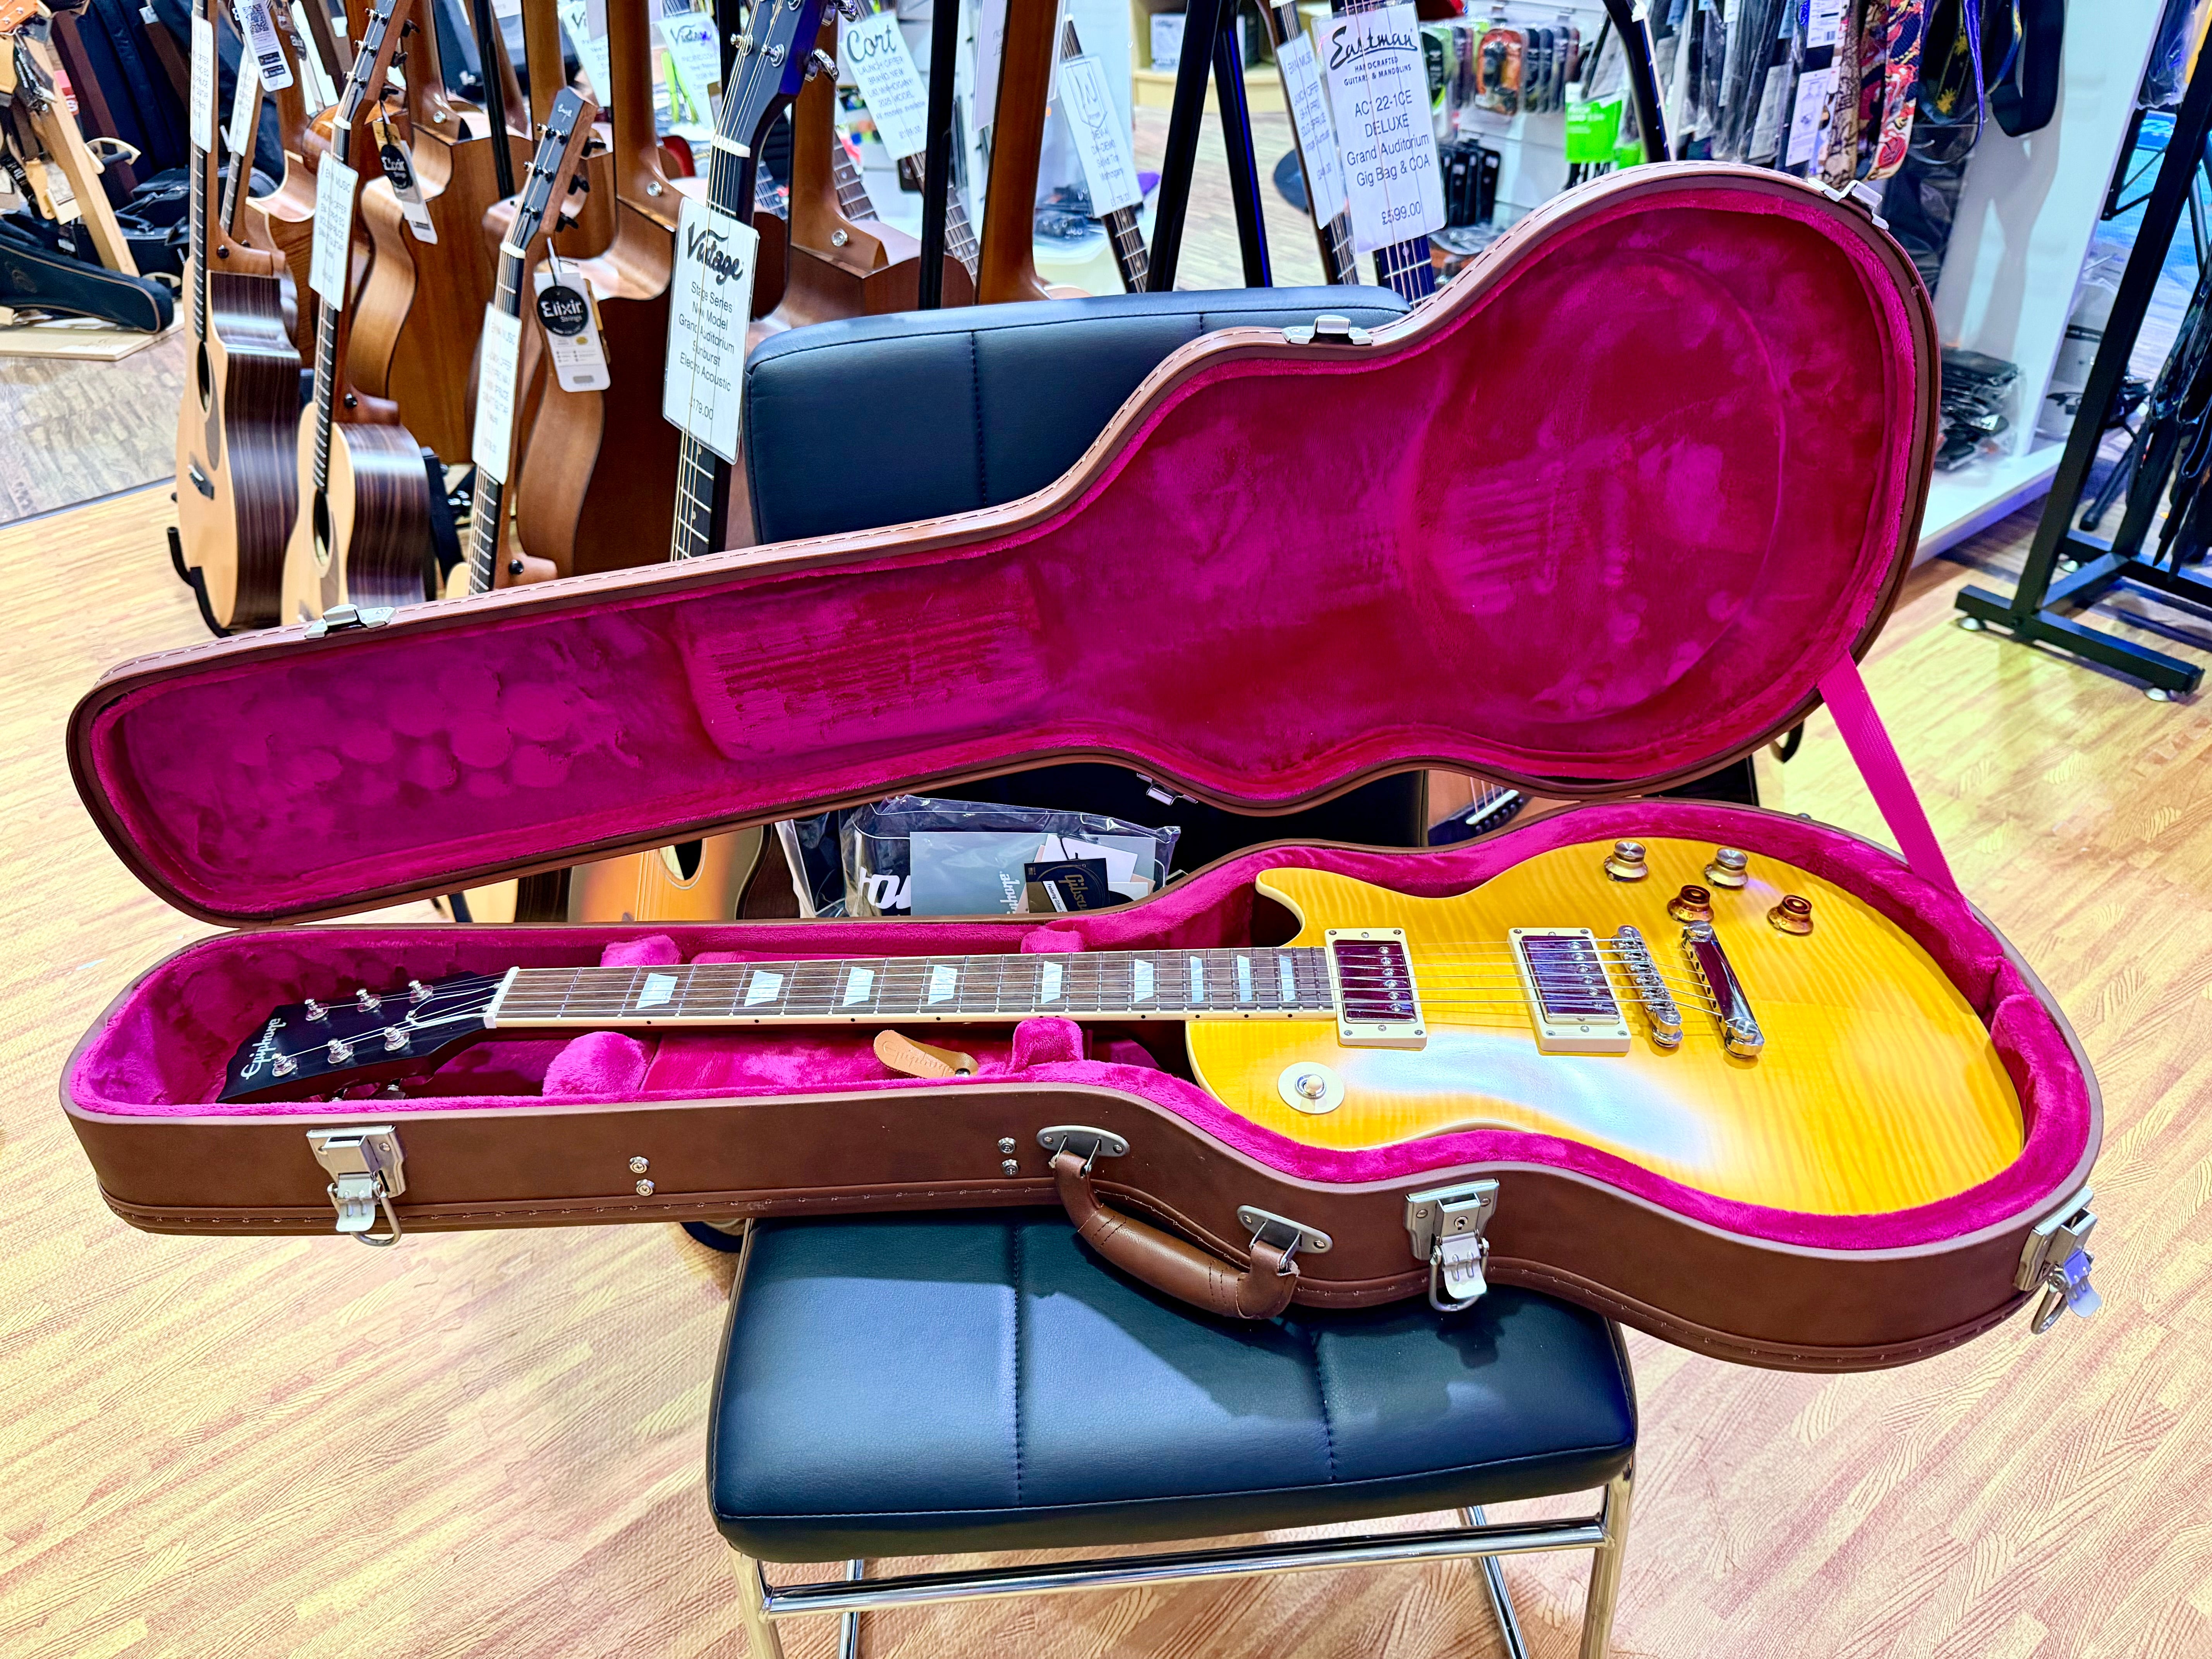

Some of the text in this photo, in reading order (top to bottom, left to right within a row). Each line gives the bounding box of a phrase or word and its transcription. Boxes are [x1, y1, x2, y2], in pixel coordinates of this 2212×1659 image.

[847, 24, 896, 64] Cort
[1330, 26, 1417, 70] Eastman
[1379, 64, 1412, 78] MANDOLINS
[1365, 113, 1410, 137] DELUXE
[1347, 134, 1429, 166] Grand Auditorium
[1357, 154, 1430, 187] Gig Bag & COA
[1382, 201, 1421, 225] £599.00
[687, 222, 743, 285] Vintage
[541, 299, 583, 318] Elixir
[692, 301, 728, 330] Nw Model
[709, 292, 733, 313] Series
[693, 340, 720, 367] Sunburst
[700, 325, 735, 354] Auditorium
[680, 352, 731, 392] Elecro Acoustic
[240, 1018, 287, 1080] Epiphone
[882, 1041, 953, 1077] Epiphon
